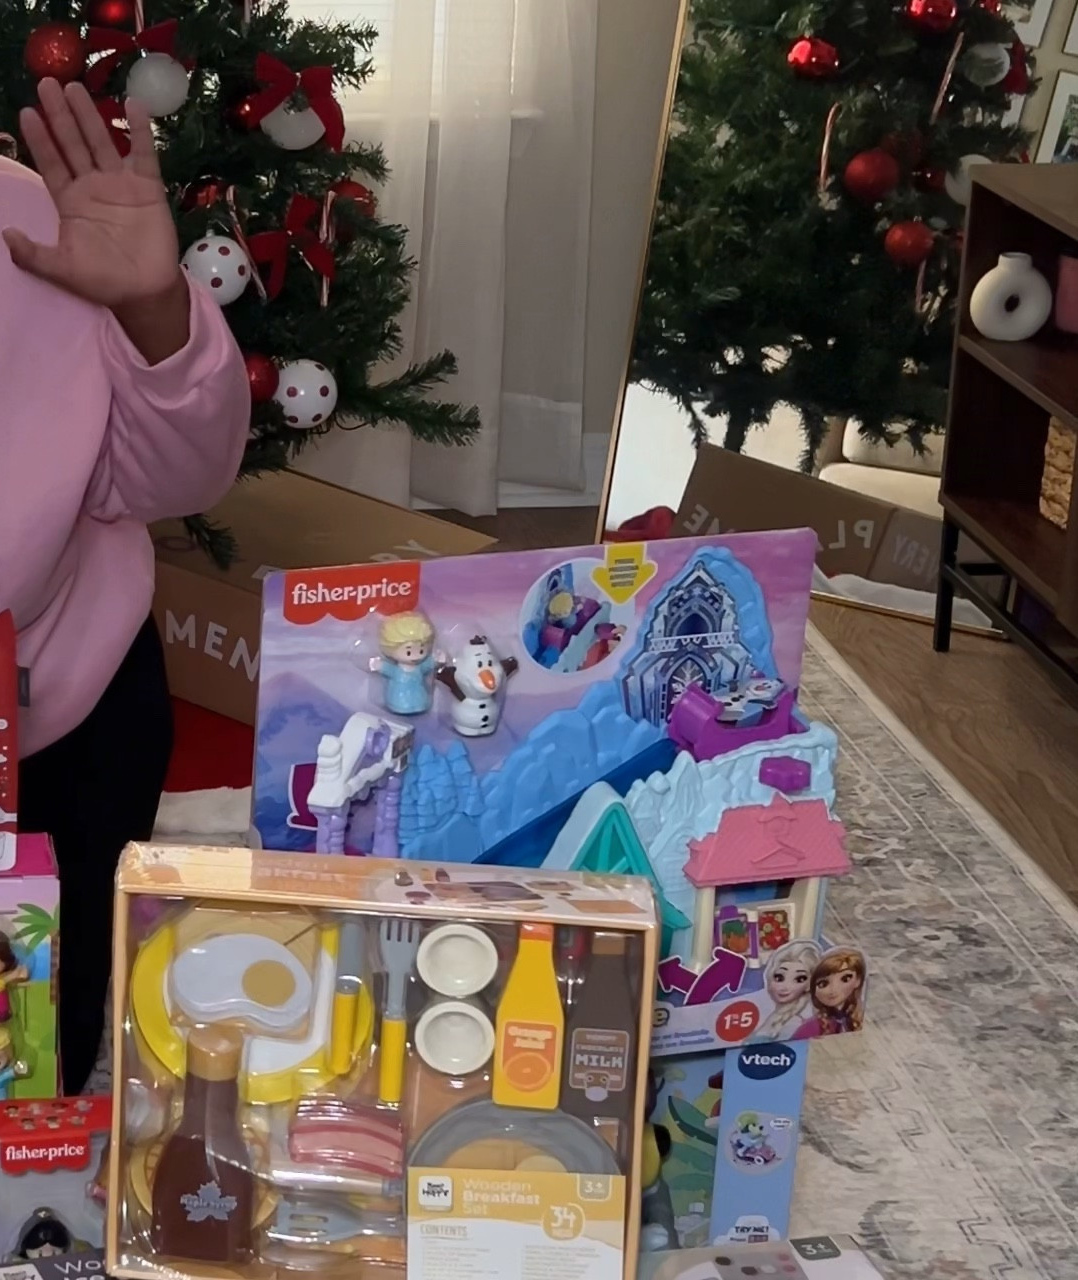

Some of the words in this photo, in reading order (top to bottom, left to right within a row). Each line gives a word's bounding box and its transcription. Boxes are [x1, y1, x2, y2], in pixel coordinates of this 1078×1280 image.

[291, 577, 412, 606] fisher-price
[574, 1053, 623, 1068] MILK
[741, 1053, 791, 1067] vtech
[5, 1144, 85, 1161] fisher-price
[462, 1178, 531, 1193] Wooden
[462, 1190, 540, 1206] Breakfast
[462, 1204, 488, 1216] Set
[551, 1205, 577, 1228] 34
[735, 1225, 752, 1234] TRY
